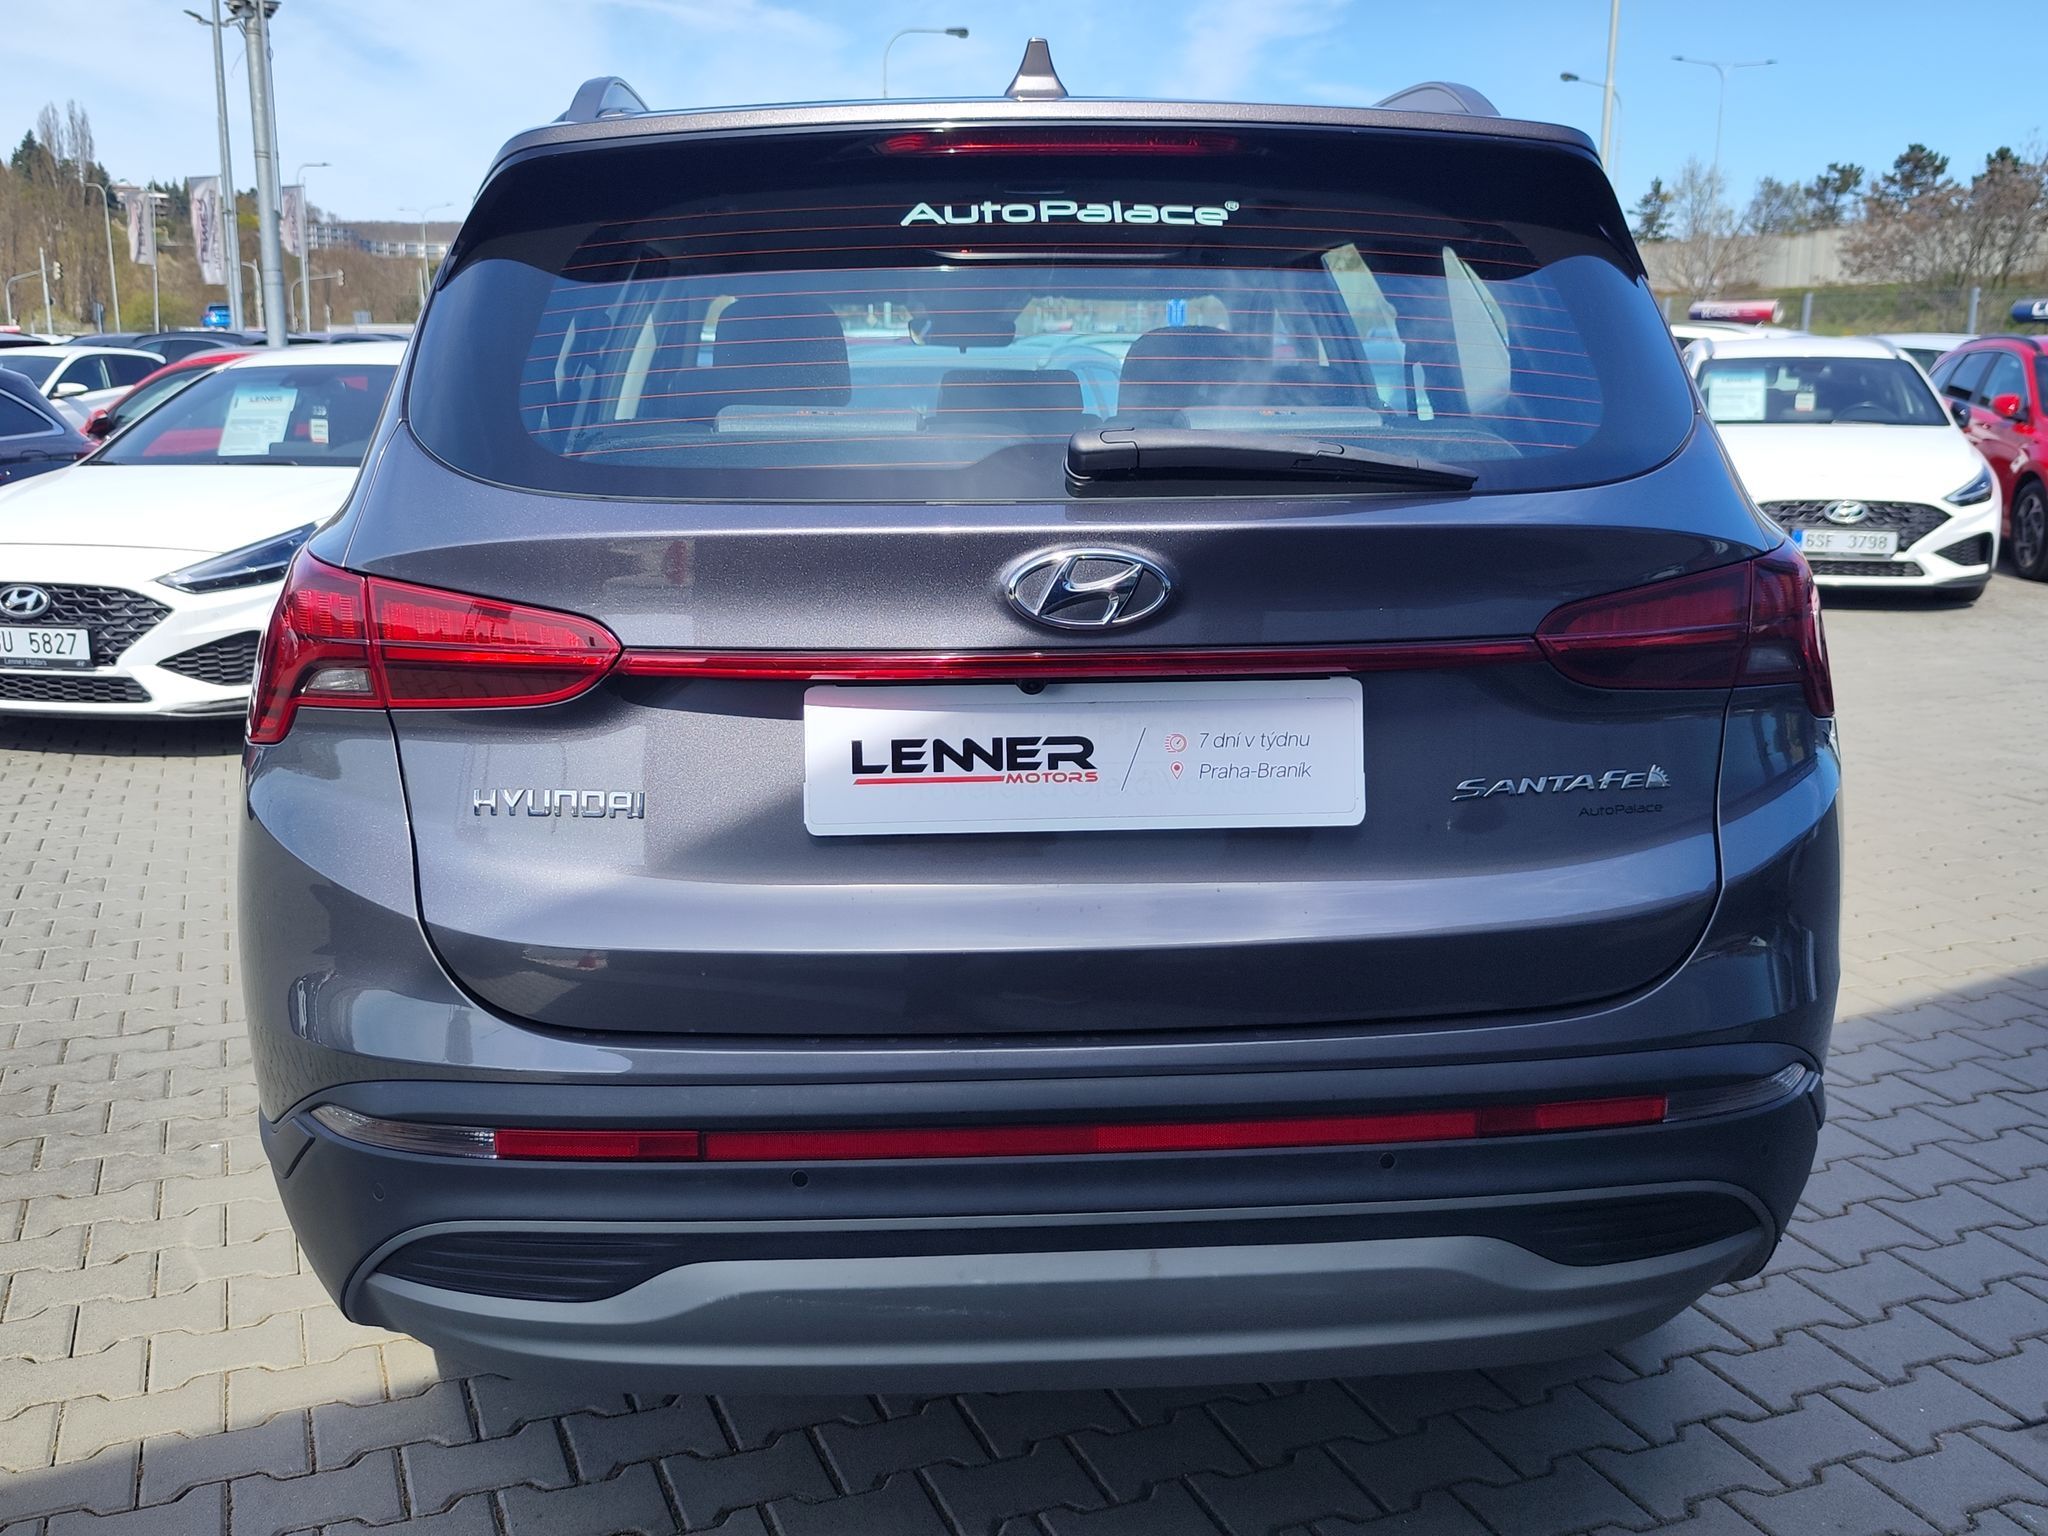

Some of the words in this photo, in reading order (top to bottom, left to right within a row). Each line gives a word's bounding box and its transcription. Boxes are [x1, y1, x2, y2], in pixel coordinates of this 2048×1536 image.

[1847, 535, 1888, 550] 3798
[28, 632, 77, 655] 5827
[1199, 732, 1210, 749] 7
[1213, 731, 1240, 749] dní
[1245, 735, 1256, 748] v
[1260, 730, 1311, 751] týdnu
[851, 735, 1098, 775] LENNER
[1004, 771, 1099, 785] MOTORS
[1199, 761, 1312, 779] Praha-Braník
[473, 788, 646, 819] HYUNDAI
[1578, 803, 1664, 817] AutoPalace
